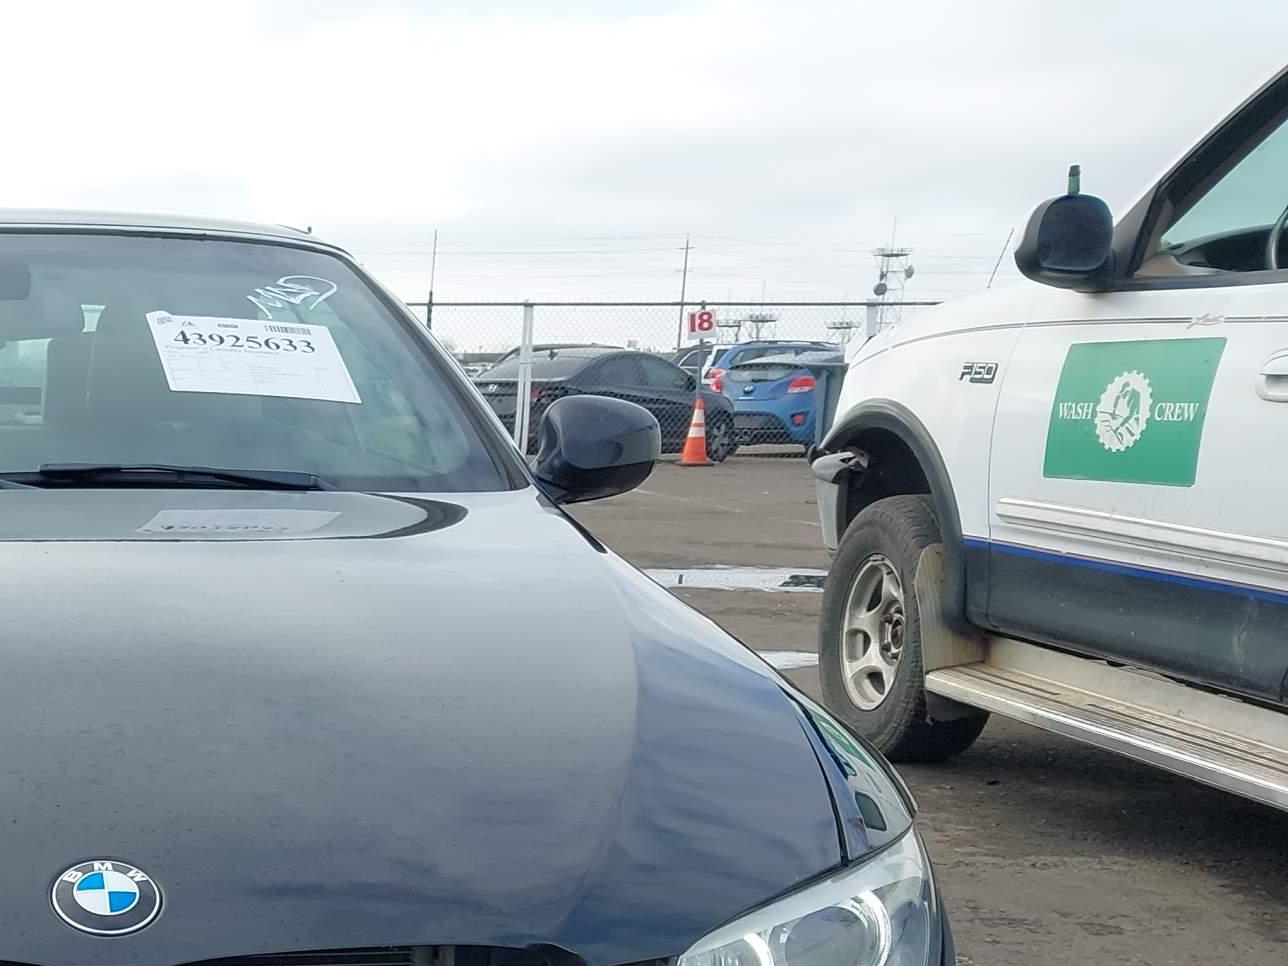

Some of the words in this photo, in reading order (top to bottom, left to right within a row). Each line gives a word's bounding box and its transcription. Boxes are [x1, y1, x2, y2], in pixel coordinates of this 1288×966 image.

[690, 311, 713, 333] 18
[173, 329, 316, 354] 43925633
[1058, 402, 1094, 420] WASH
[1154, 402, 1199, 421] CREW
